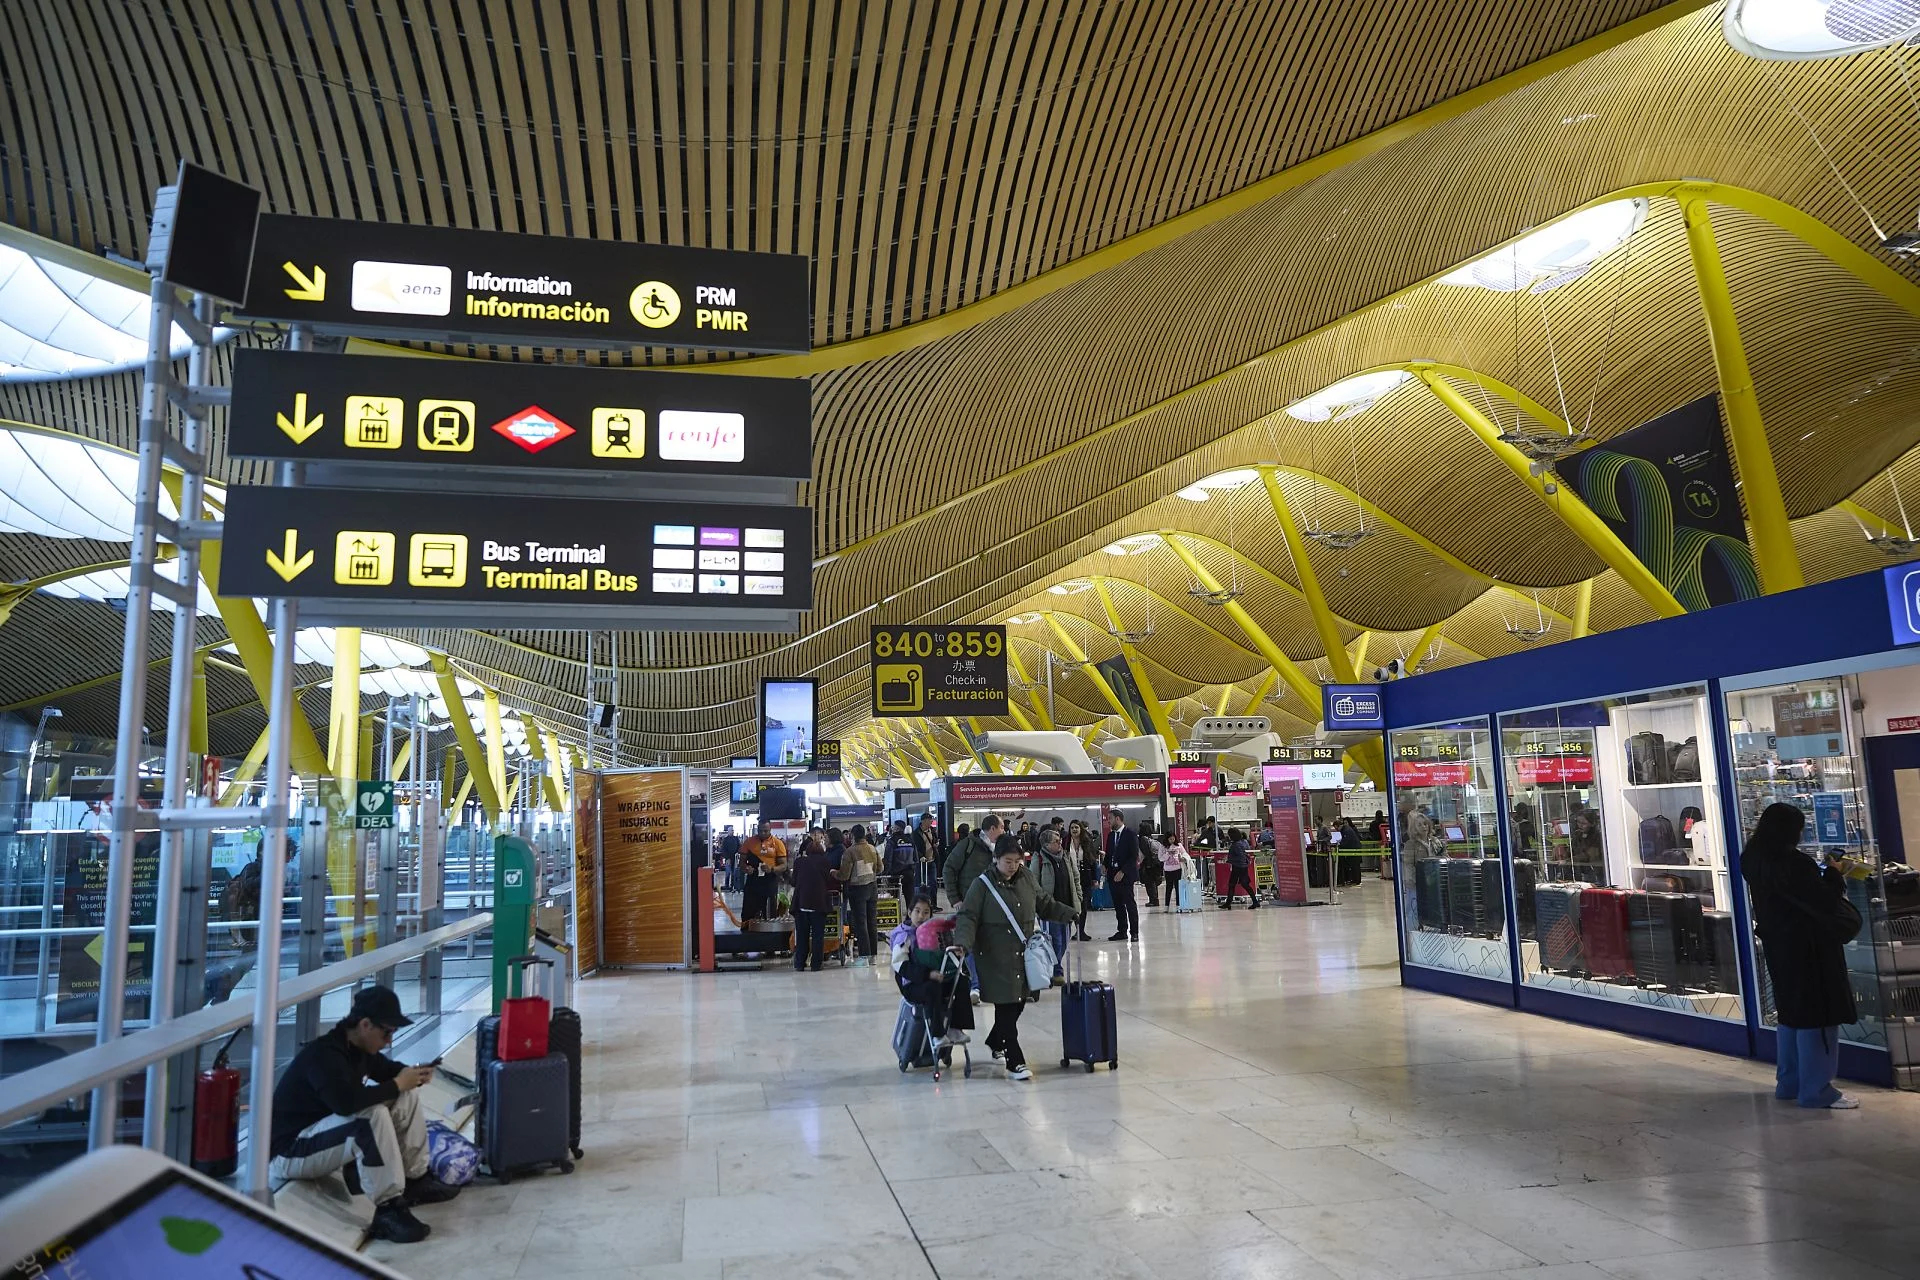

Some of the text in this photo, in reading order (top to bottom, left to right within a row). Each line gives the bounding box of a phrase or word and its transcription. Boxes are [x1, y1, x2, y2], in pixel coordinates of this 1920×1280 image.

[467, 270, 572, 296] Information
[402, 284, 441, 296] aena
[696, 286, 736, 306] PRM
[466, 295, 609, 323] Información
[696, 309, 748, 332] PMR
[668, 426, 736, 448] renfe
[1688, 492, 1712, 507] T4
[483, 540, 606, 564] Bus Terminal
[482, 566, 588, 590] Terminal
[594, 569, 638, 591] Bus
[875, 631, 1002, 657] 840 to a 859
[952, 660, 976, 672] 办票
[945, 674, 986, 685] Check-in
[928, 687, 1004, 700] Facturación
[1792, 711, 1814, 720] SALES
[1400, 746, 1419, 756] 853
[1526, 743, 1544, 752] 855
[1563, 743, 1582, 751] 856
[1180, 752, 1200, 762] 850
[1273, 749, 1291, 758] 851
[1313, 749, 1332, 758] 852
[617, 801, 670, 812] WRAPPING
[361, 817, 389, 828] DEA
[619, 817, 669, 828] INSURANCE
[622, 833, 667, 843] TRACKING
